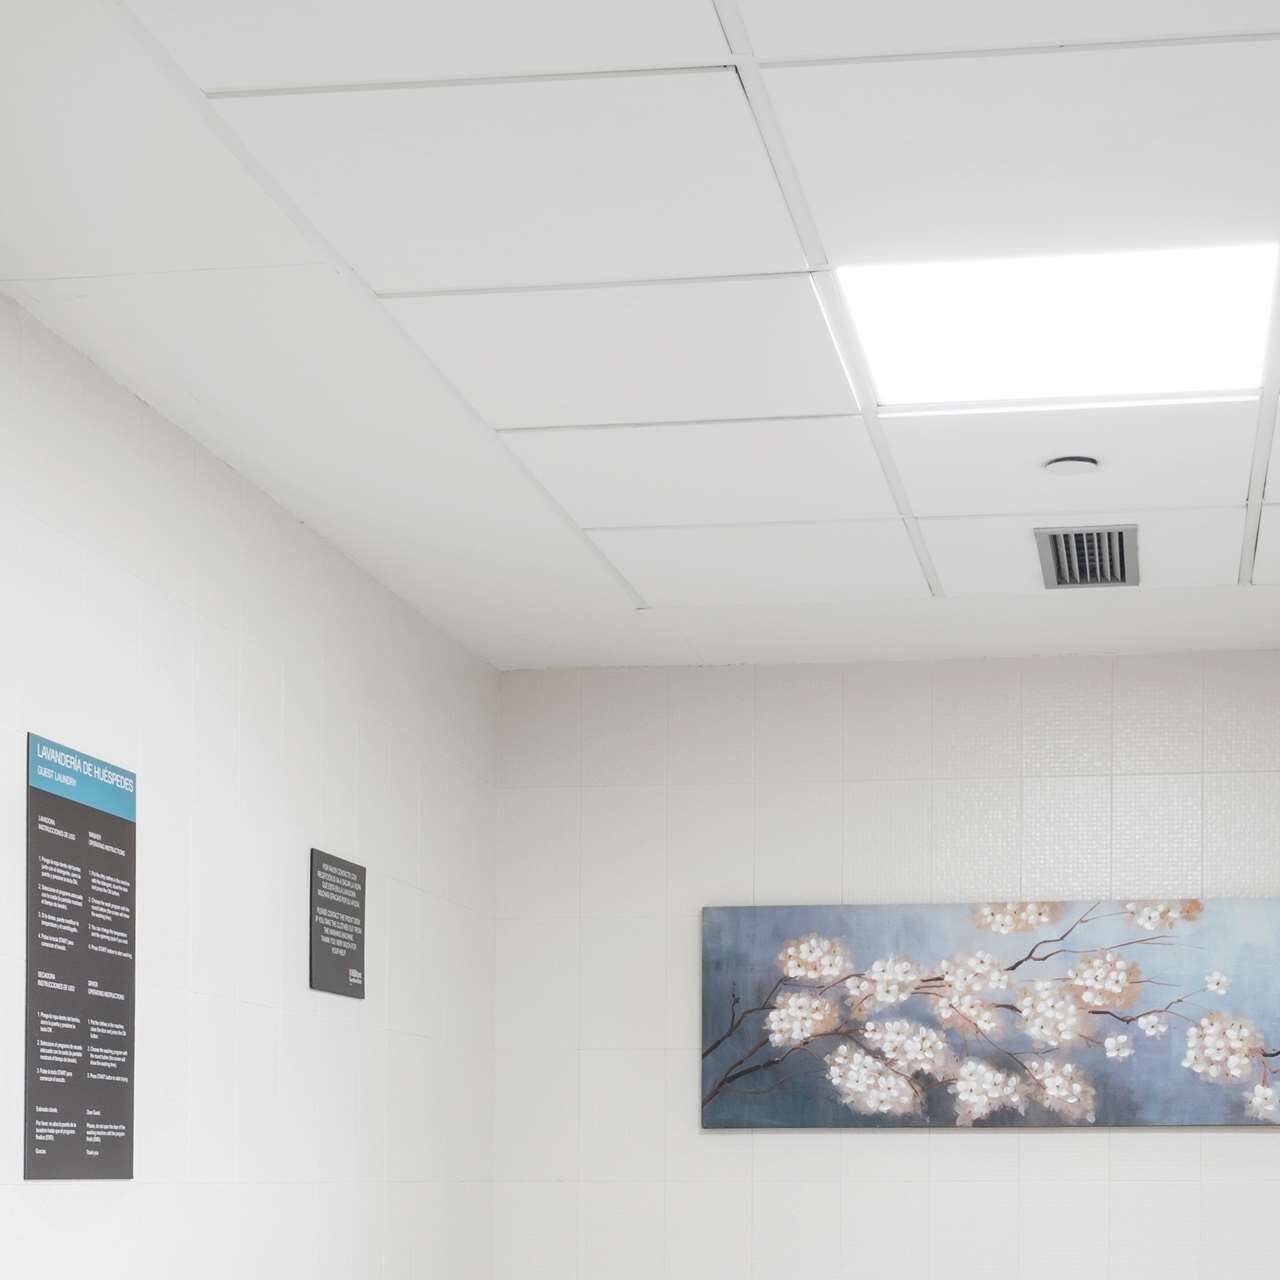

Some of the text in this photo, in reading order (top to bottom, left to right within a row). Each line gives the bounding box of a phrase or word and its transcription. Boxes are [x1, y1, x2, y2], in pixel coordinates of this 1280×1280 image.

[37, 744, 134, 793] LAVANDERÍA DE HUÉSPEDES
[37, 765, 54, 779] GUEST
